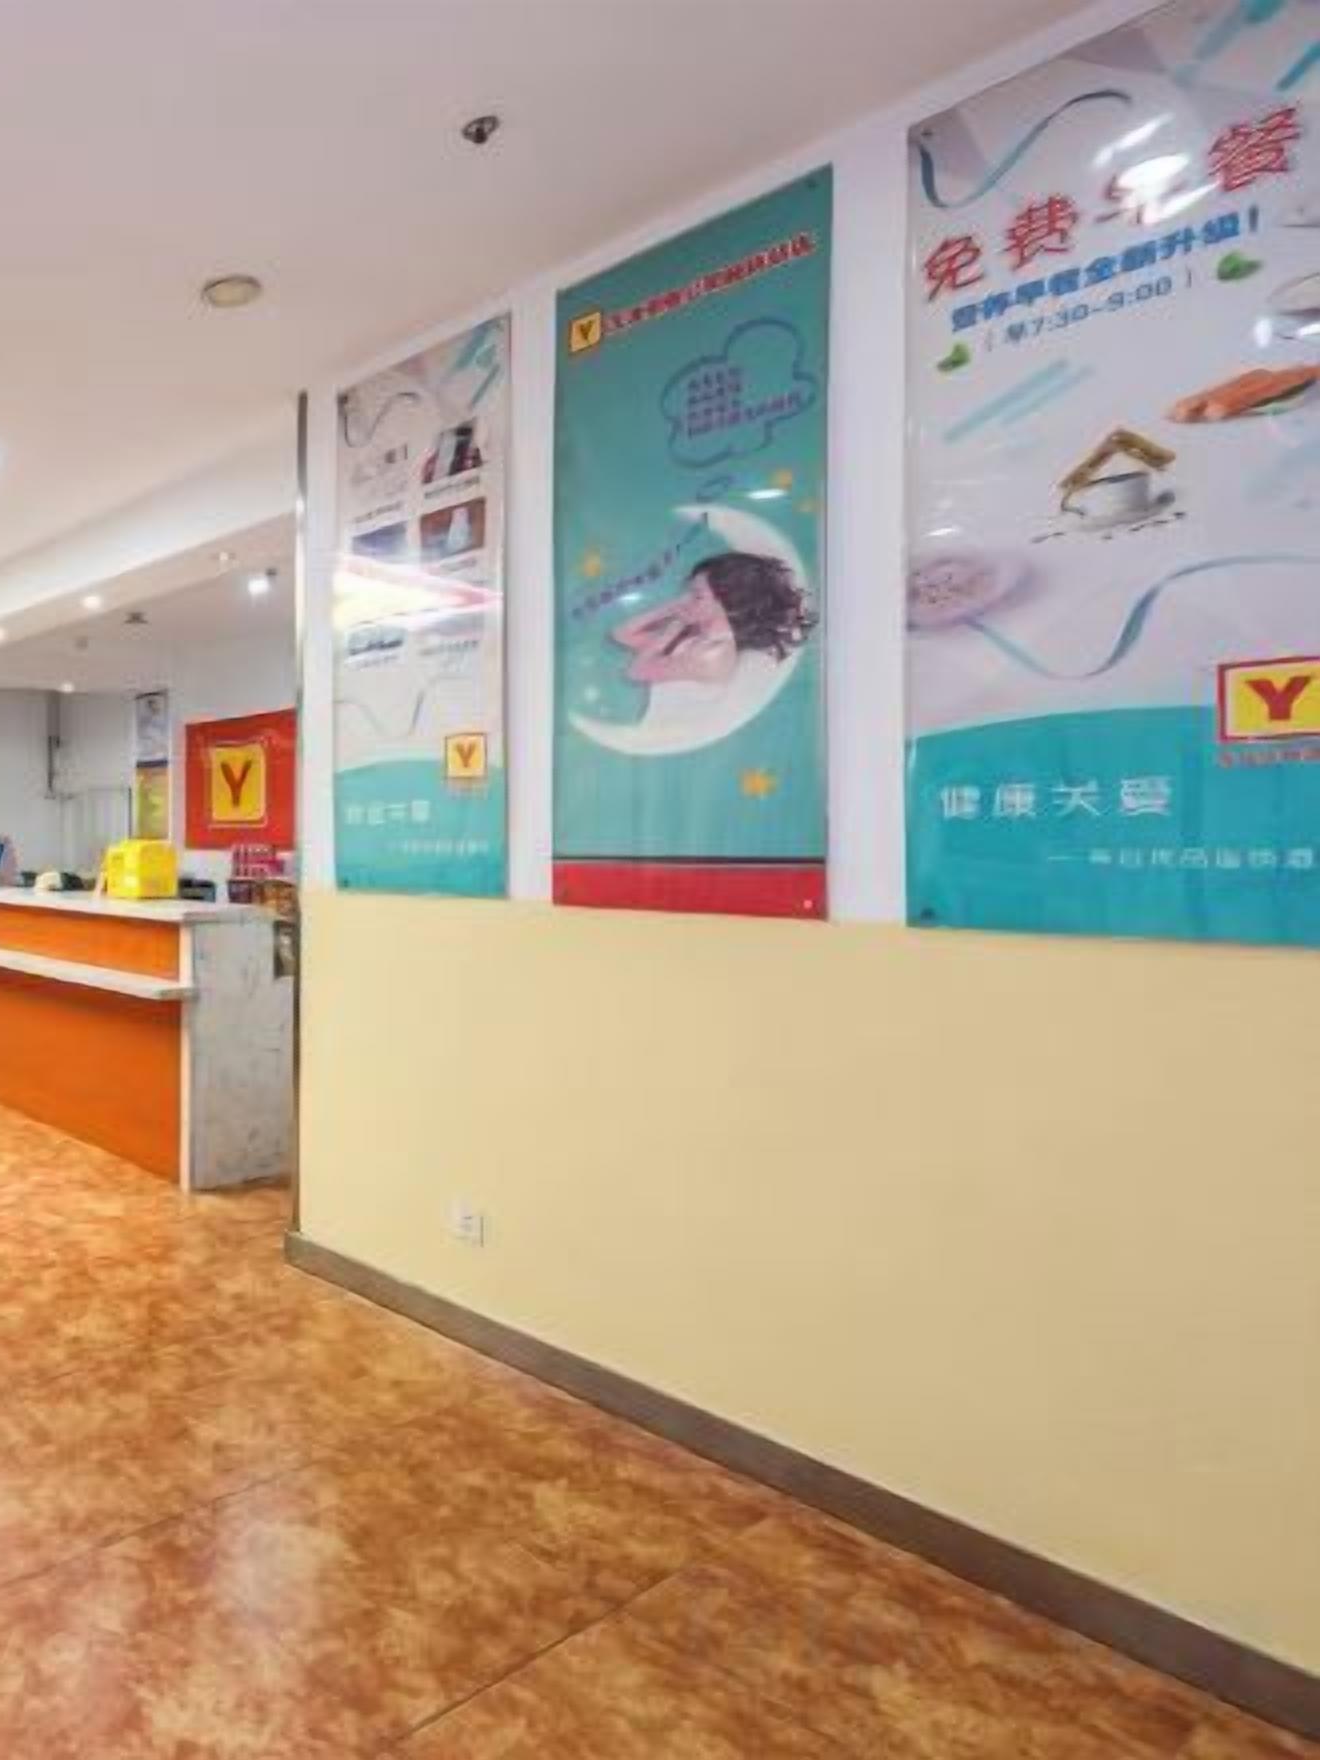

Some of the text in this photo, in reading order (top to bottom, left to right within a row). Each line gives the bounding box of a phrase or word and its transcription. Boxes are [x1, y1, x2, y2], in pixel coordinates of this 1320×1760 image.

[923, 106, 1301, 303] 免费餐
[1245, 674, 1315, 721] Y
[220, 759, 253, 808] Y
